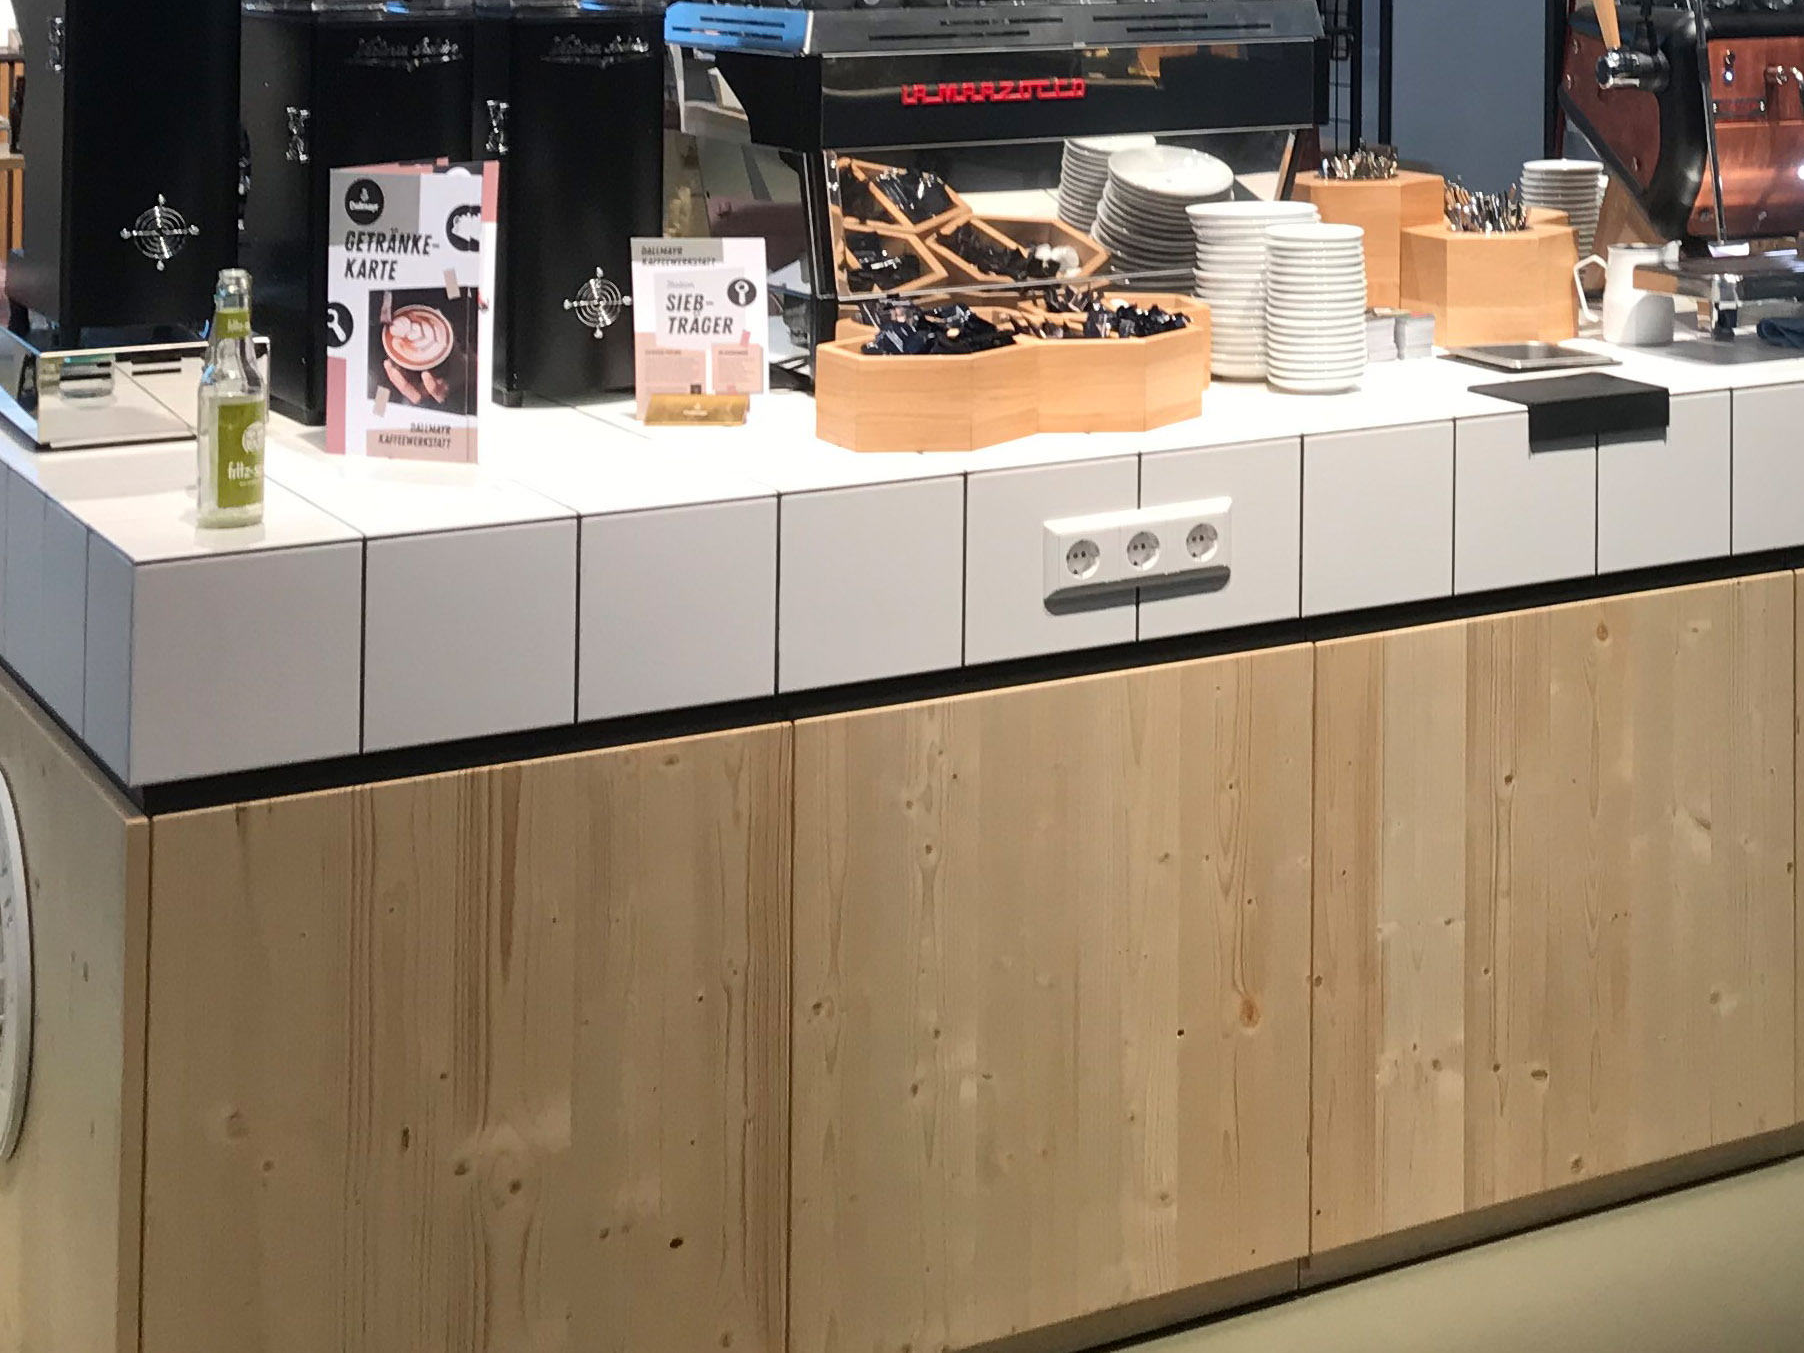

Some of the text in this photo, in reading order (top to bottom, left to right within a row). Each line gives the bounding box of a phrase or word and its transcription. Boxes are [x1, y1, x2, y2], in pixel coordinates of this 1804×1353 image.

[345, 227, 440, 256] GETRÄNKE-
[345, 258, 398, 280] KARTE
[666, 293, 714, 313] SIEB-
[668, 311, 733, 335] TRÄGER
[410, 422, 451, 435] DALLMAYR
